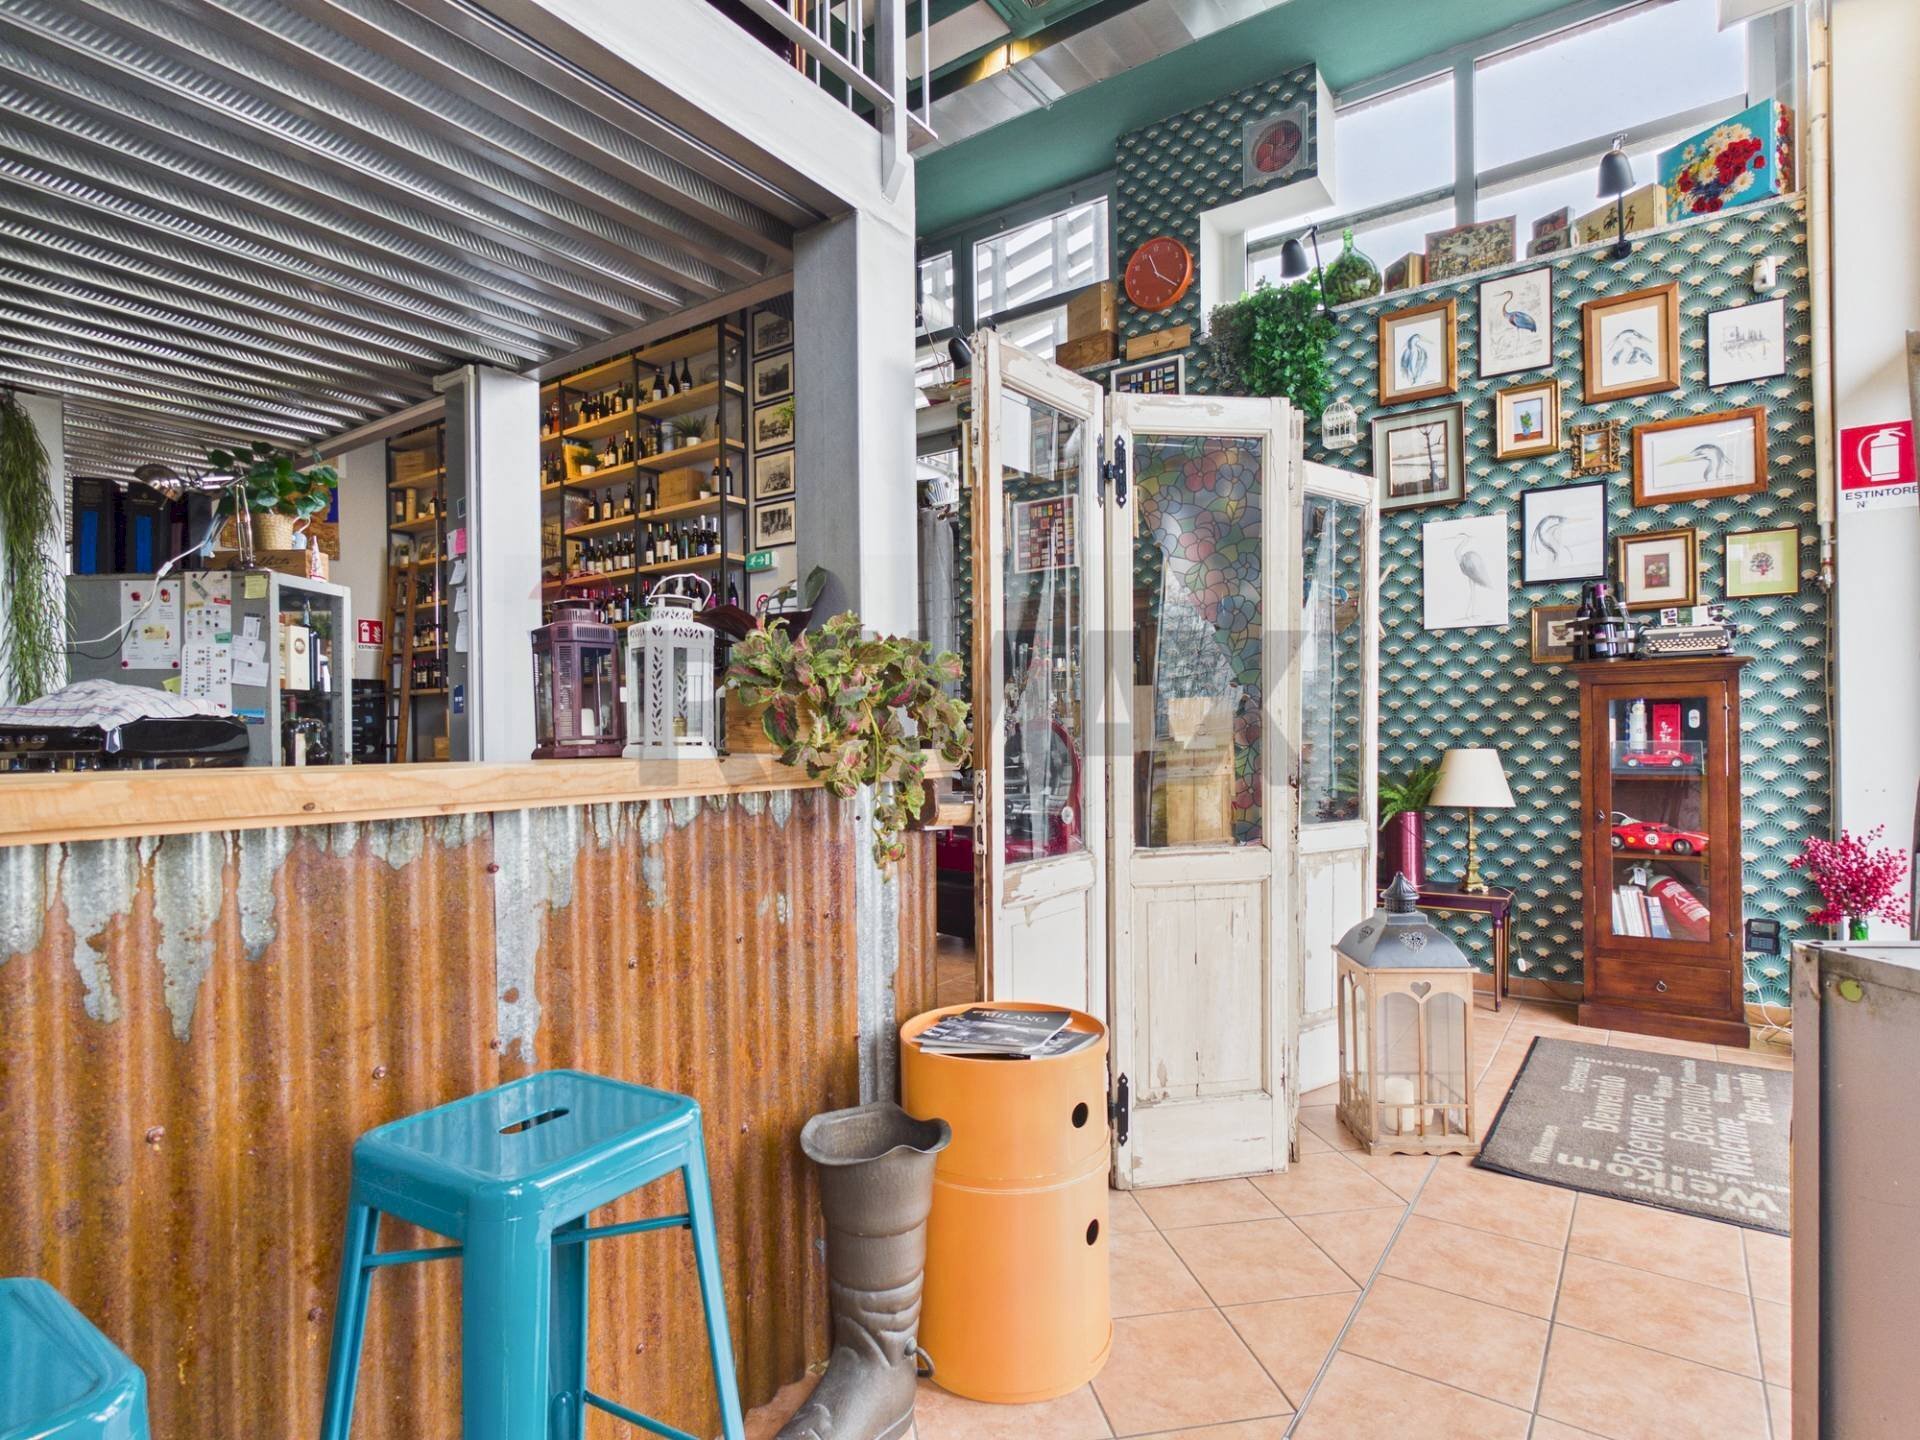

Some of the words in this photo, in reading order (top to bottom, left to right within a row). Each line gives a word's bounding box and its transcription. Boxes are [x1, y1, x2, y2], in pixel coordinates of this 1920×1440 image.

[1845, 486, 1919, 501] ESTINTORE
[981, 1011, 1049, 1023] MILANO
[1582, 1074, 1627, 1133] Bienvenido
[1670, 1082, 1716, 1145] Benvenuto
[1732, 1072, 1774, 1125] Bem-vindo
[1612, 1094, 1665, 1170] Bienvenue
[1710, 1117, 1755, 1177] Welcome
[1556, 1152, 1782, 1213] Welkom
[1624, 1181, 1769, 1218] Bienvenue
